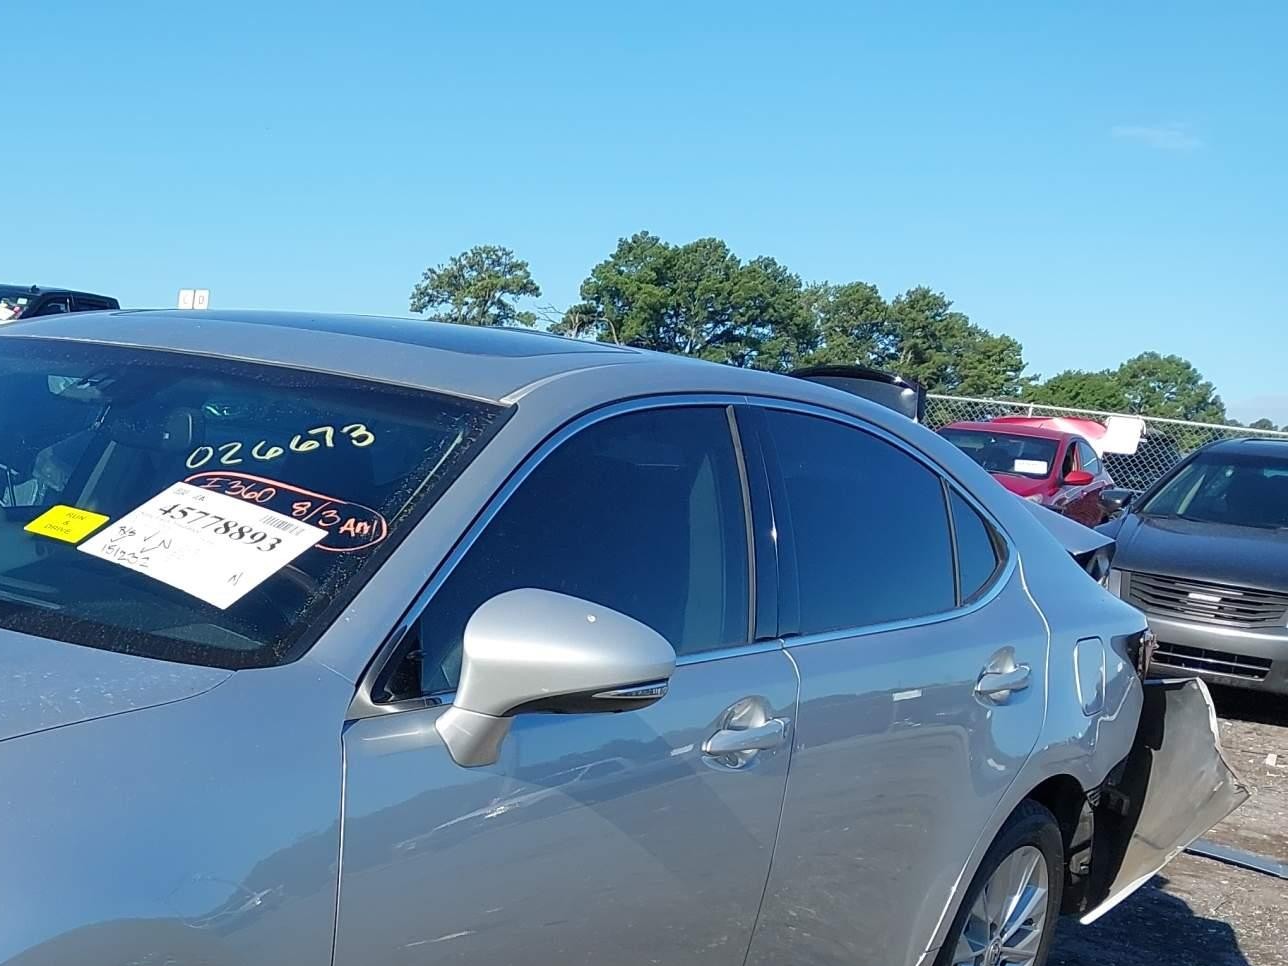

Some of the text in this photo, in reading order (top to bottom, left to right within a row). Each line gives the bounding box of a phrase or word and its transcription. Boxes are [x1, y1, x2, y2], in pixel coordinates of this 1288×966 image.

[186, 423, 375, 469] 026673
[43, 522, 73, 535] DRIVE
[65, 512, 88, 521] RUN
[159, 503, 283, 553] 45778893
